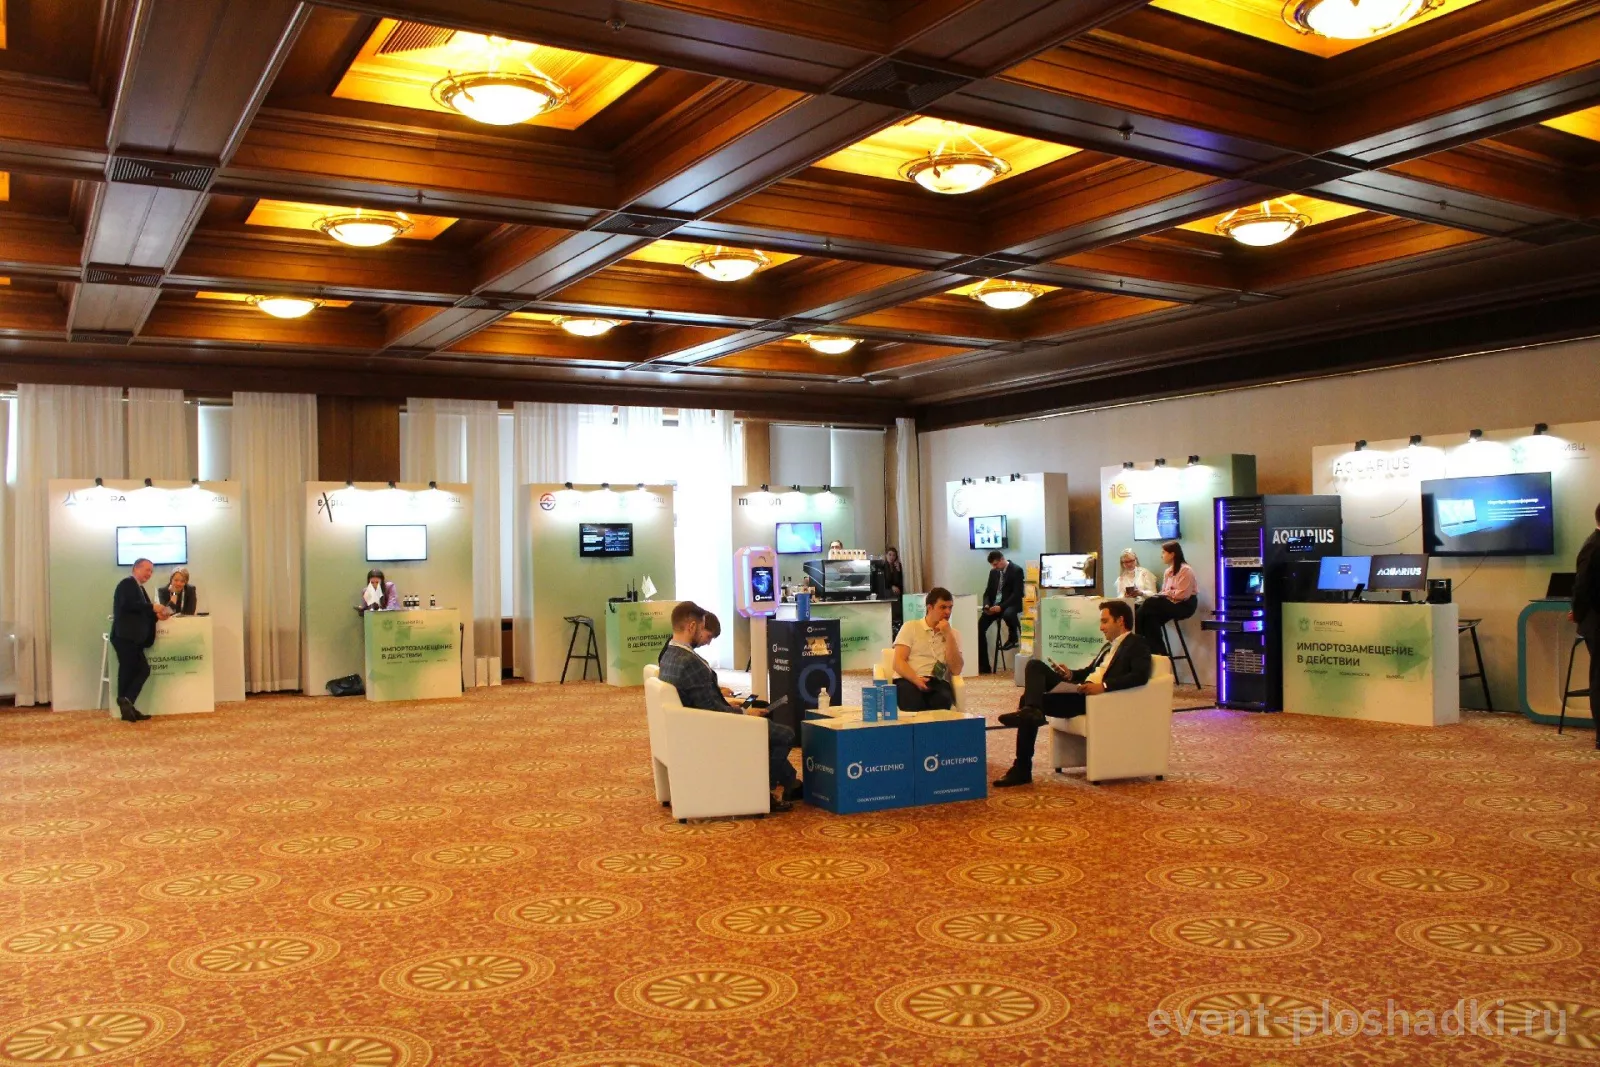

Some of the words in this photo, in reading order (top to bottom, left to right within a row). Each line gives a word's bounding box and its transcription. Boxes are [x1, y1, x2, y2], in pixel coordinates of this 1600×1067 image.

[1376, 567, 1422, 576] AQUARIUS
[1296, 642, 1414, 656] ИМПОРТОЗАМЕЩЕНИЕ
[1297, 655, 1303, 663] В
[1306, 654, 1360, 666] ДЕЙСТВИИ
[940, 756, 978, 766] СИСТЕМКО
[864, 763, 904, 773] СИСТЕМКО
